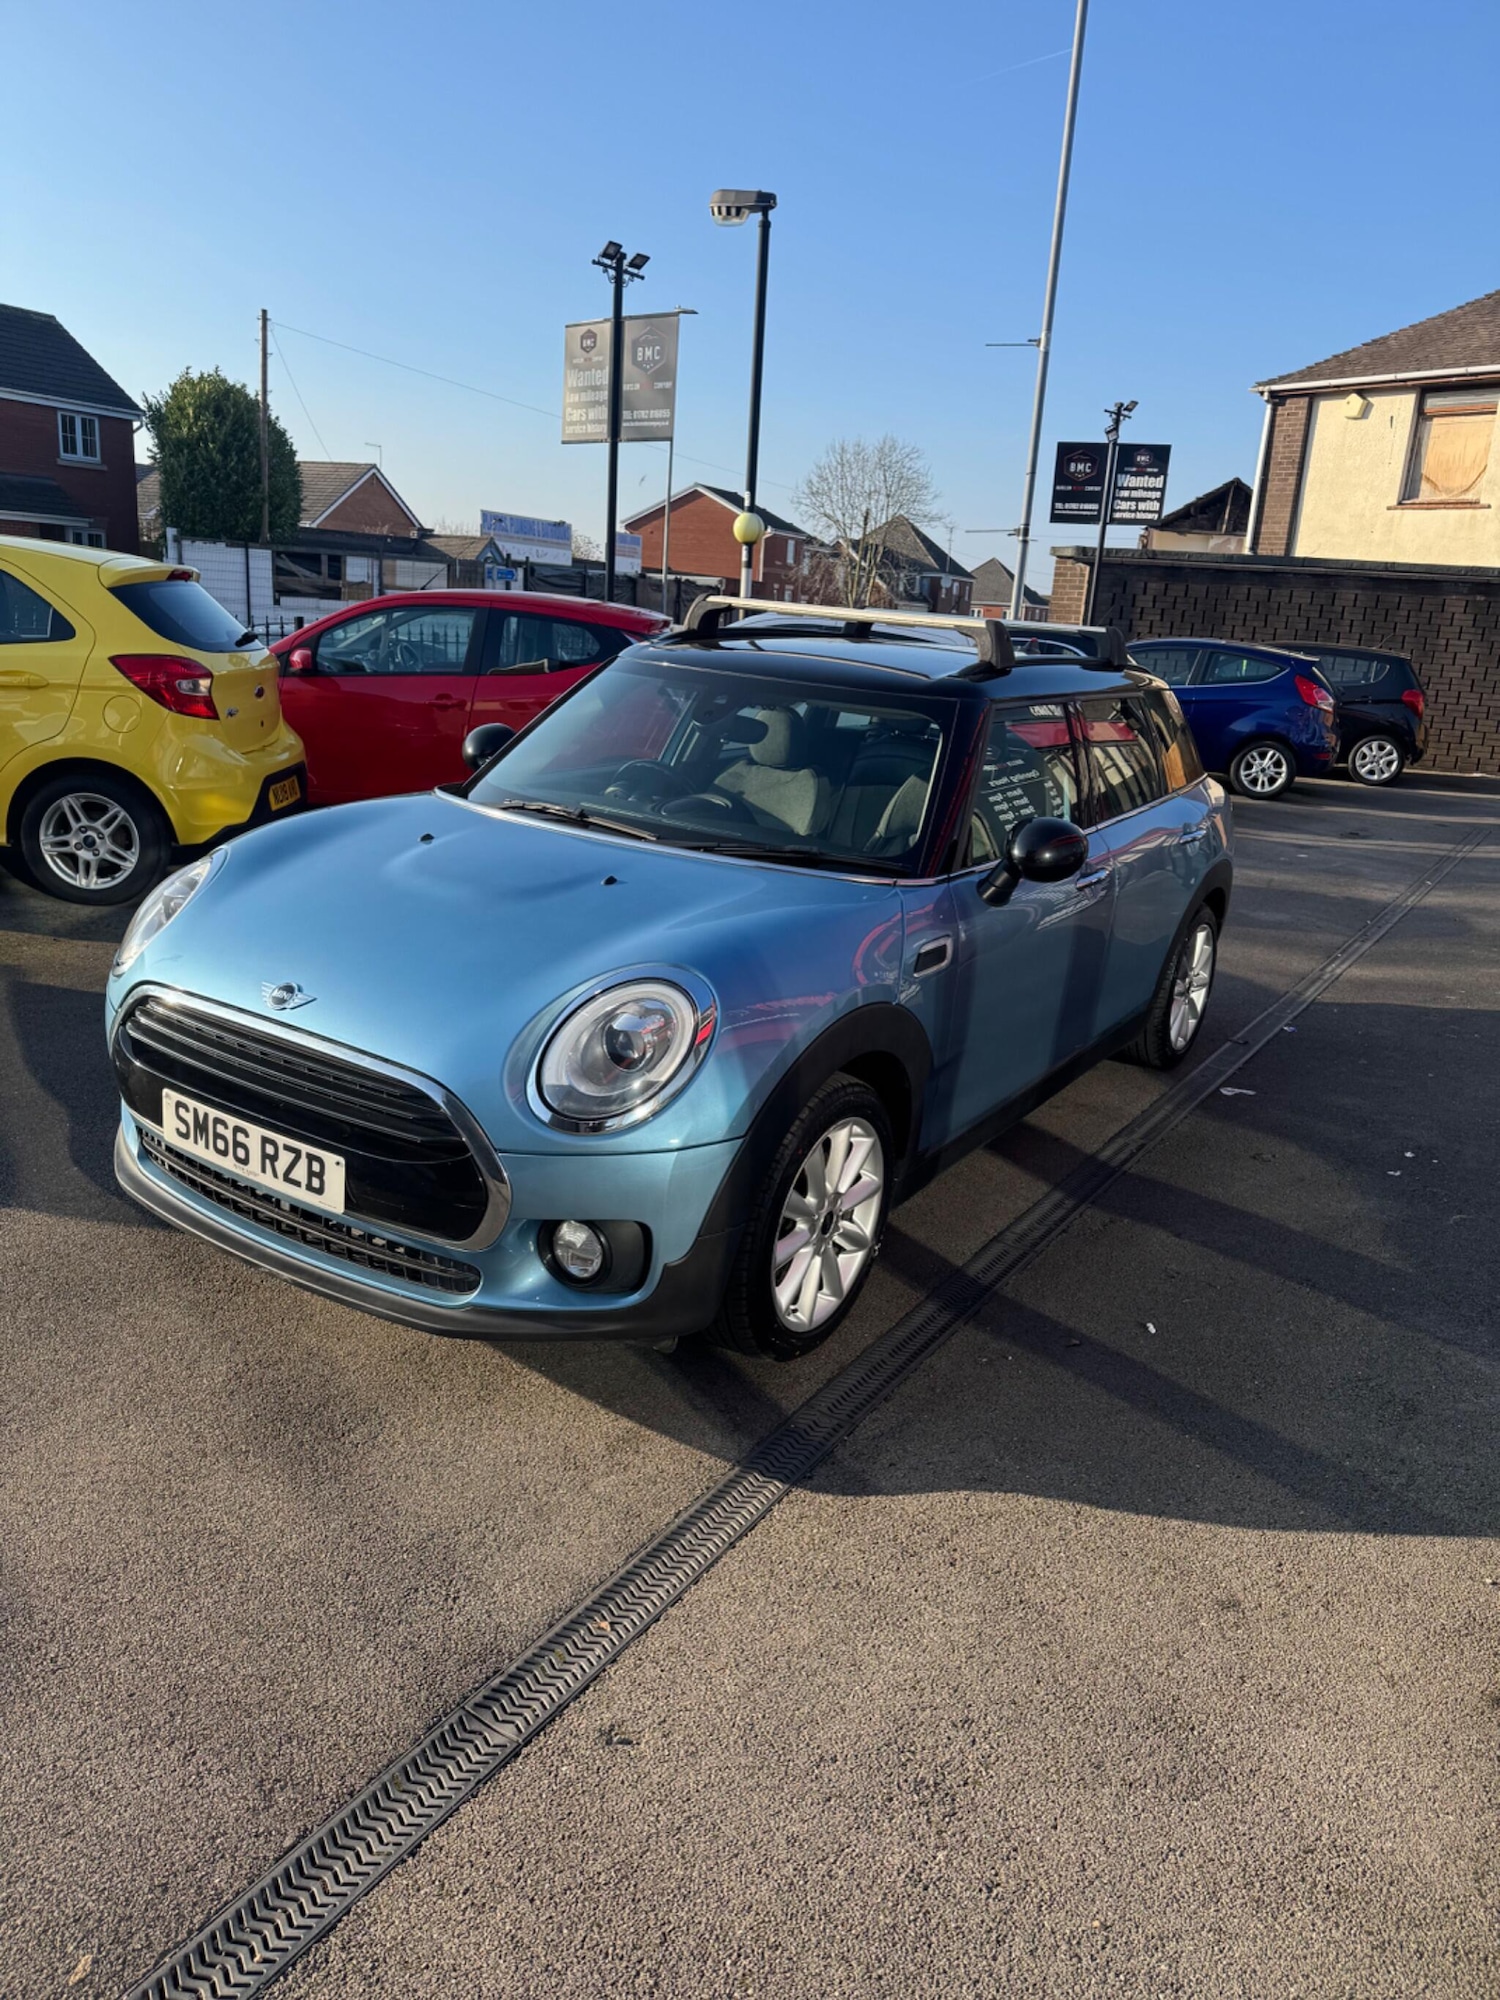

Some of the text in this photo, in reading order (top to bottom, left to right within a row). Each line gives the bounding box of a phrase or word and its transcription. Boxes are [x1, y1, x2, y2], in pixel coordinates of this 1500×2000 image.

[636, 346, 660, 361] BMC
[567, 366, 608, 387] Wanted
[566, 389, 608, 402] Low mileage
[565, 404, 608, 421] Cars with
[565, 422, 586, 434] service
[1069, 462, 1092, 472] BMC
[1117, 474, 1164, 488] Wanted
[1115, 489, 1161, 499] Low mileage
[1113, 499, 1160, 511] Cars with
[1112, 511, 1159, 520] service history
[175, 1100, 326, 1196] SM66 RZB
